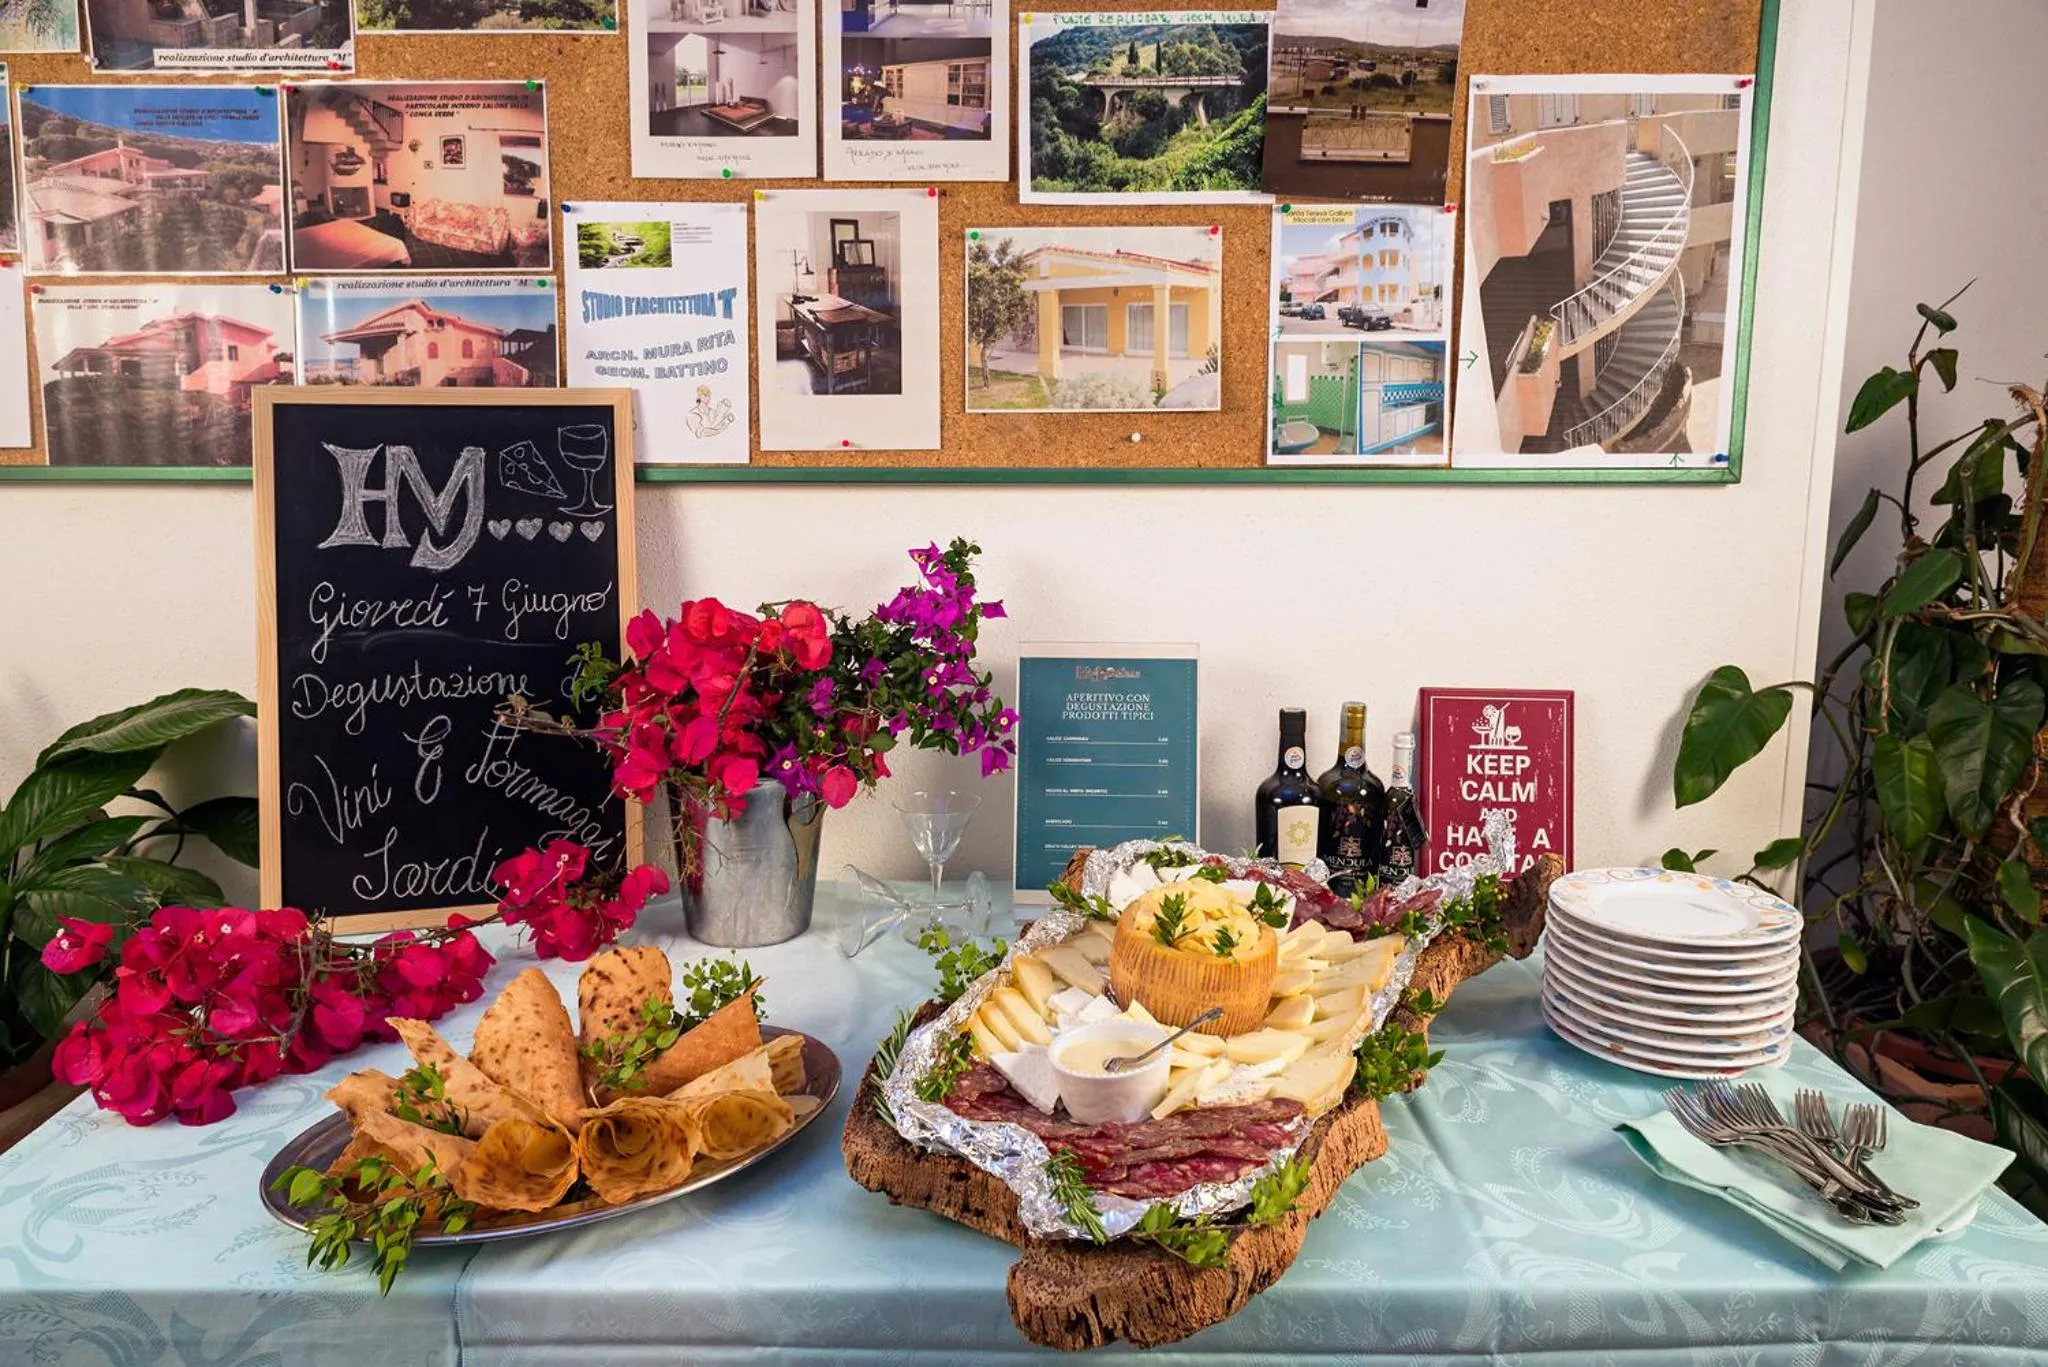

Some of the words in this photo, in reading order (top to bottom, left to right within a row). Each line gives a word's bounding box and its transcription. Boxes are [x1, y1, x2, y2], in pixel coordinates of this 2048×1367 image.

[158, 53, 224, 62] realizzazione
[227, 52, 257, 62] studio
[259, 52, 329, 62] d'architettura
[336, 279, 404, 290] realizzazione
[406, 279, 438, 289] studio
[439, 278, 511, 288] d'architettura
[581, 289, 623, 325] STUDIO
[584, 349, 639, 362] ARCH.
[642, 341, 694, 360] MURA
[696, 329, 736, 352] RITA
[594, 365, 650, 380] GEOM.
[653, 356, 729, 380] BATTINO
[467, 583, 489, 623] 7
[500, 578, 613, 641] Giugno
[291, 658, 536, 736] Degustazione
[1066, 693, 1124, 702] APERITIVO
[1126, 693, 1151, 703] CON
[1066, 702, 1151, 711] DEGUSTAZIONE
[1062, 711, 1119, 720] PRODOTTI
[1121, 711, 1155, 721] TIPICI
[1466, 753, 1531, 776] KEEP
[287, 753, 393, 845] Vini
[1461, 779, 1536, 803] CALM
[1478, 807, 1518, 822] AD
[1446, 825, 1517, 849] HA
[1531, 827, 1552, 849] A
